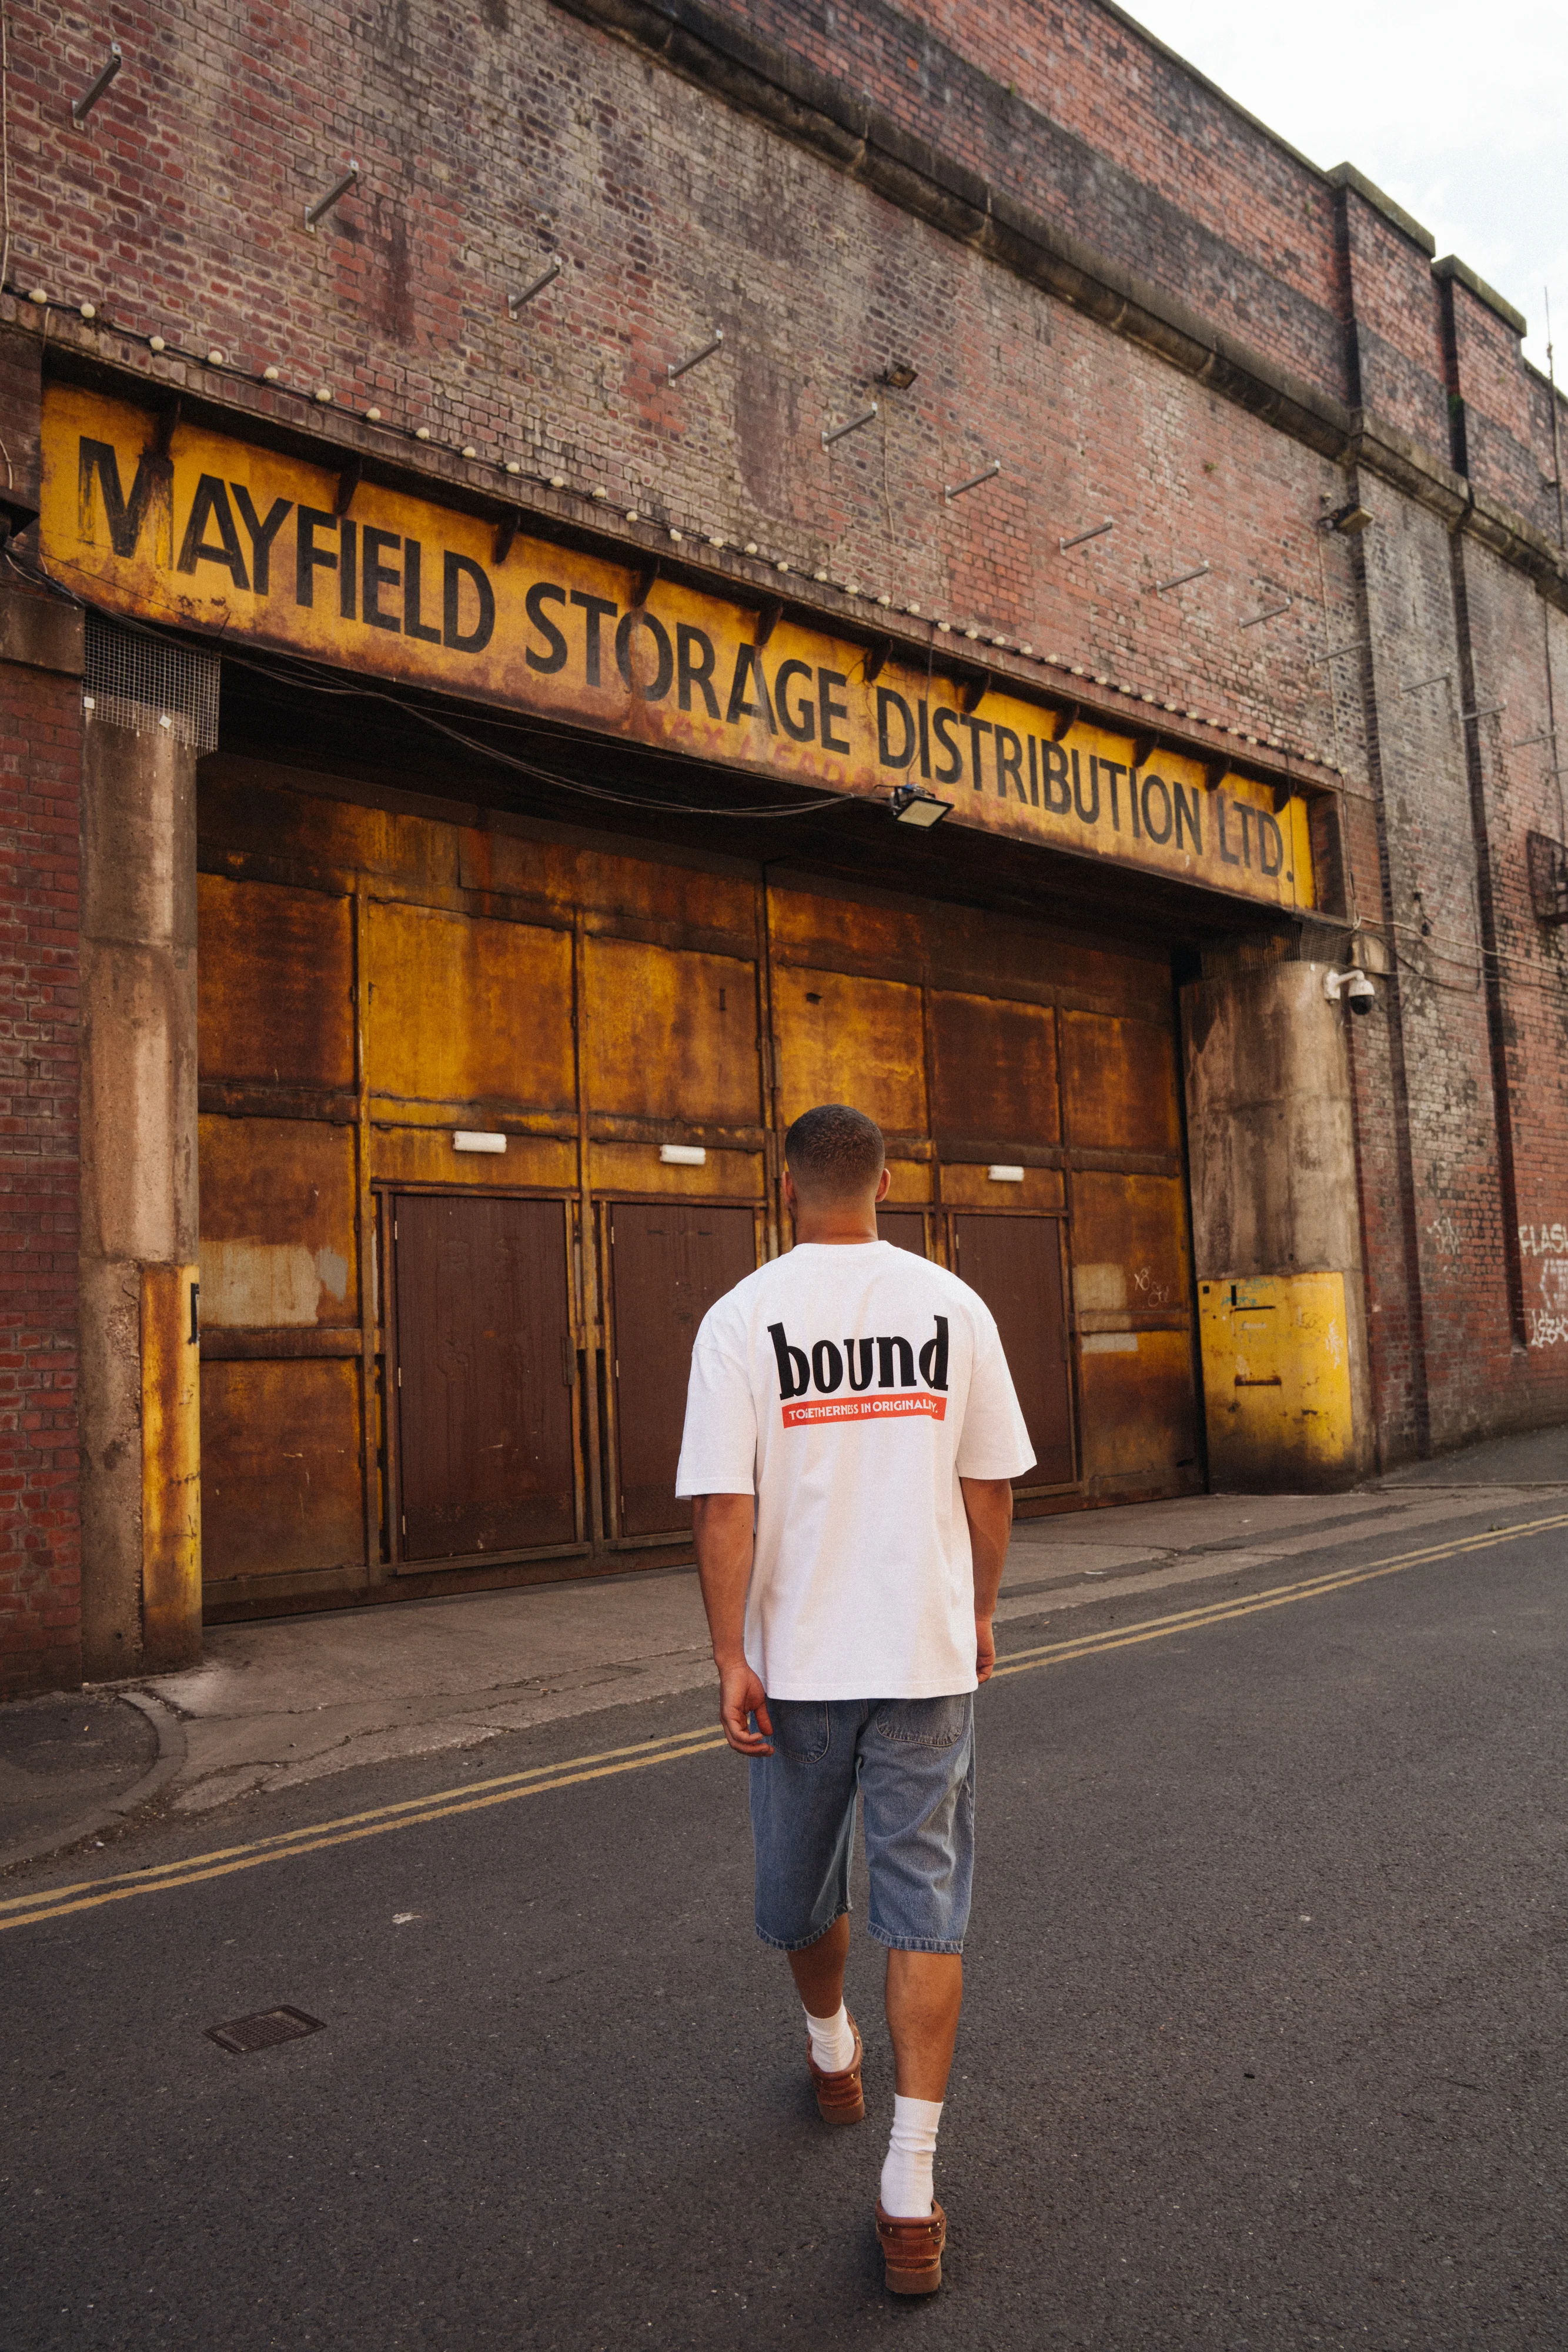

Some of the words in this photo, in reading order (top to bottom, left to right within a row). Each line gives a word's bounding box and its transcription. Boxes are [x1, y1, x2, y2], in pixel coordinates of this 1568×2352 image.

[78, 436, 495, 653] MAYFIELD
[525, 582, 850, 755] STORAGE
[876, 686, 1202, 856] DISTRIBUTION
[1216, 796, 1294, 883] LTD.
[767, 1315, 948, 1400] bound
[788, 1404, 858, 1421] TOGETHERNESS
[861, 1403, 871, 1413] IN
[872, 1399, 938, 1414] ORIGINALITY.
